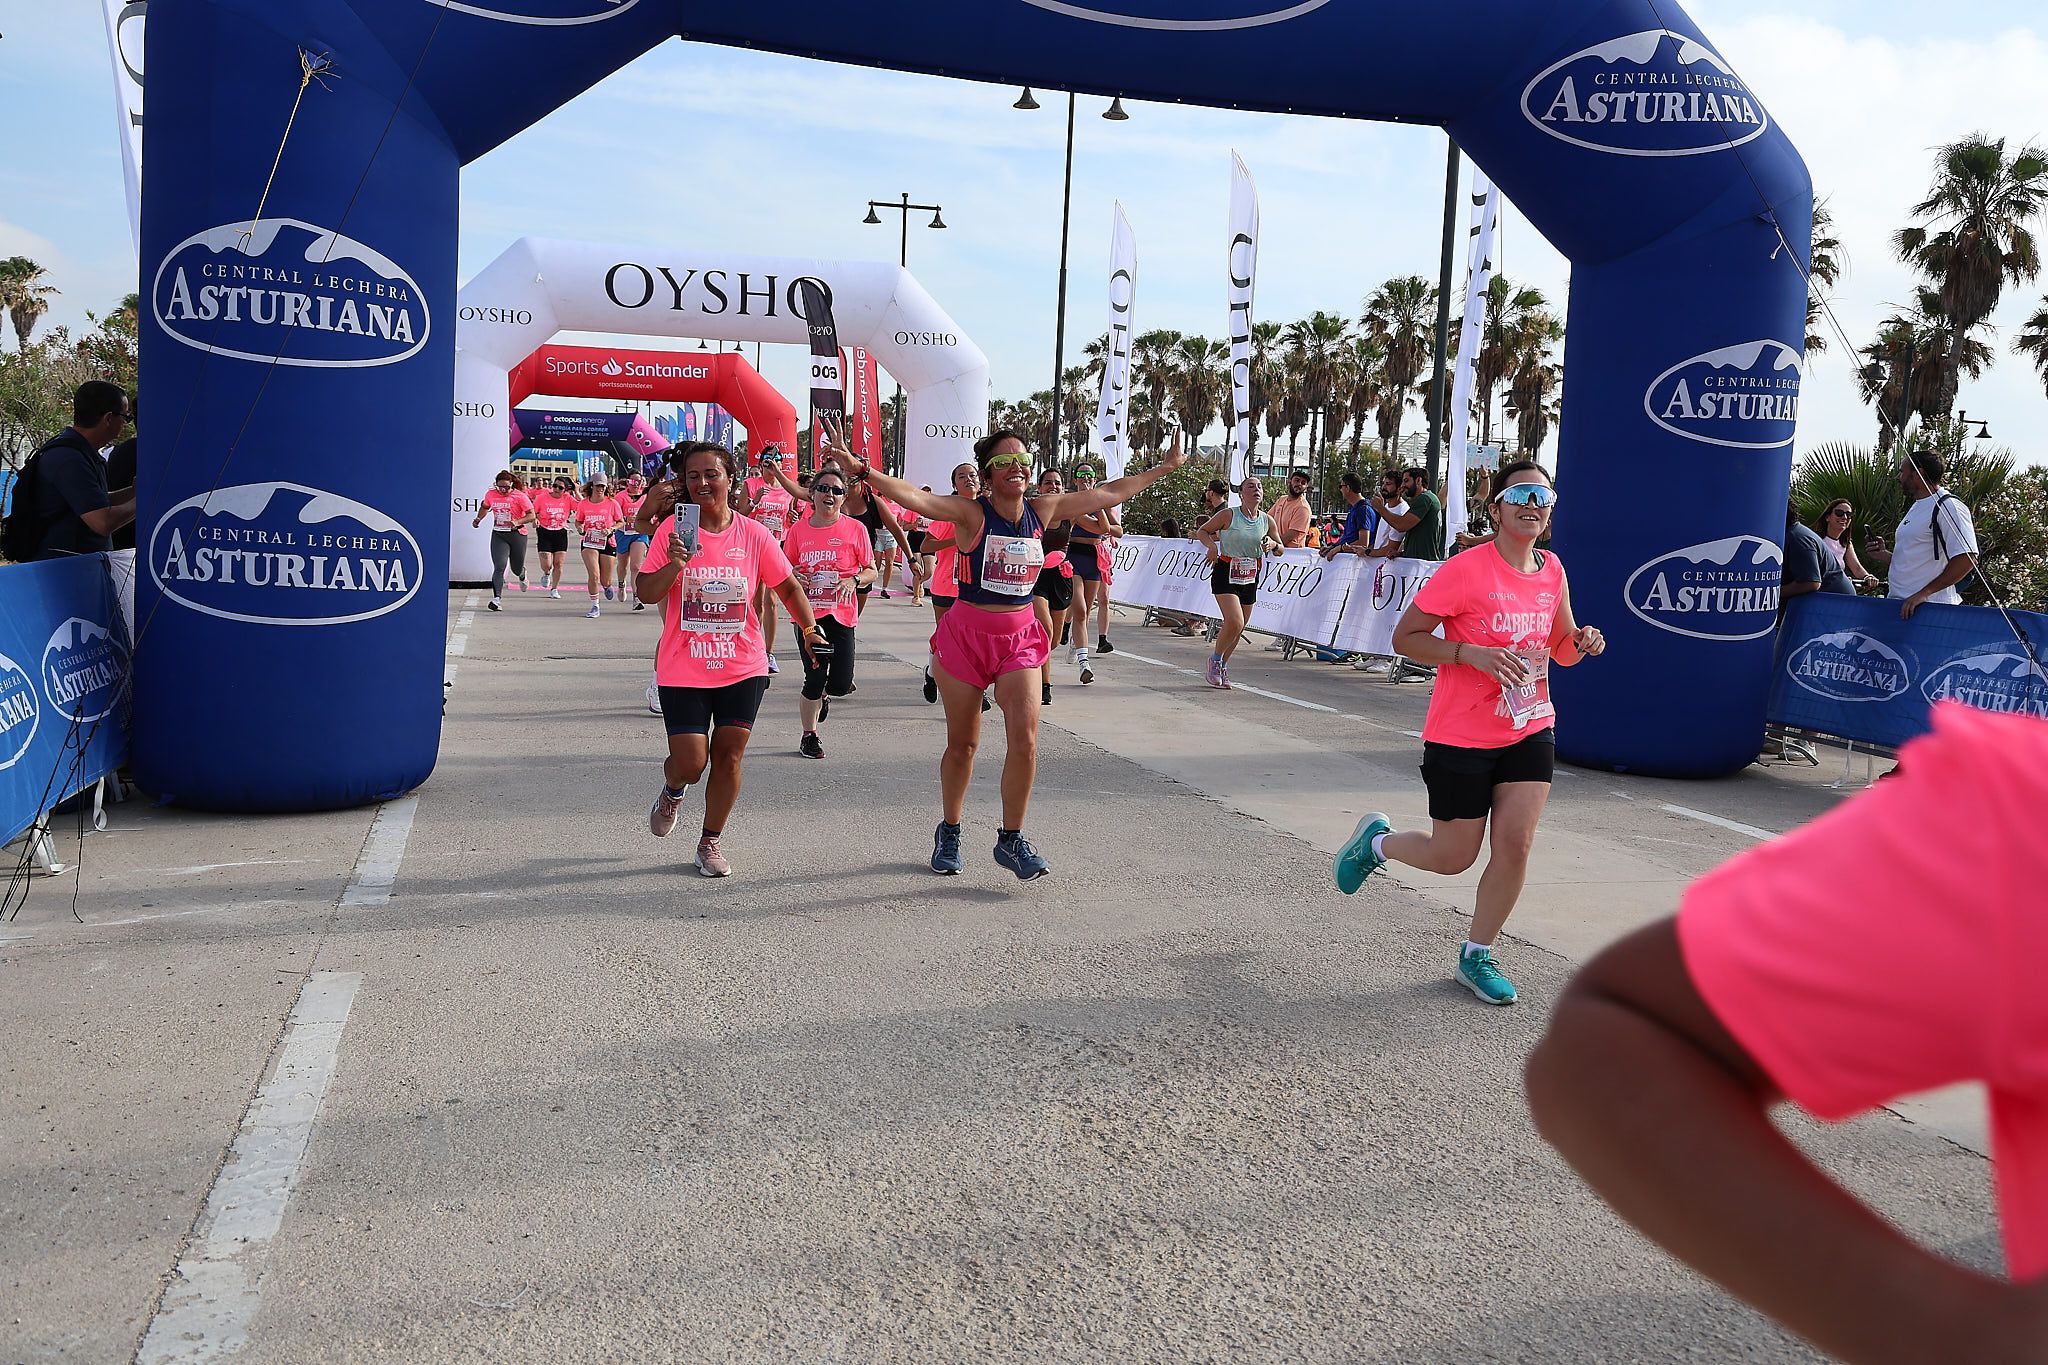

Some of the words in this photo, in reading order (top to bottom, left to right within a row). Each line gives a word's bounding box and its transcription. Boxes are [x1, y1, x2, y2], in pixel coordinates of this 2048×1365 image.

[1594, 72, 1679, 85] CENTRAL
[1685, 73, 1743, 91] LECHERA
[1541, 75, 1760, 125] ASTURIANA
[203, 263, 302, 284] CENTRAL
[314, 273, 408, 302] LECHERA
[603, 262, 834, 321] OYSHO
[164, 265, 415, 344] ASTURIANA
[459, 306, 532, 325] OYSHO
[894, 331, 957, 346] OYSHO
[546, 357, 599, 376] Sports
[625, 361, 708, 379] Santander
[599, 382, 654, 390] sportssantander.es
[1704, 376, 1771, 388] CENTRAL
[553, 416, 582, 424] octopus
[582, 418, 606, 426] energy
[924, 423, 983, 440] OYSHO
[199, 526, 296, 545] CENTRAL
[308, 535, 402, 552] LECHERA
[161, 528, 408, 592] ASTURIANA
[800, 550, 838, 563] CARRERA
[1003, 564, 1028, 575] 016
[1682, 571, 1750, 581] CENTRAL
[1257, 561, 1322, 598] YSHO
[1488, 592, 1516, 601] OYSHO
[702, 602, 727, 612] 016
[690, 642, 737, 658] MUJER
[1796, 650, 1897, 692] ASTURIANA
[1520, 682, 1537, 698] 016
